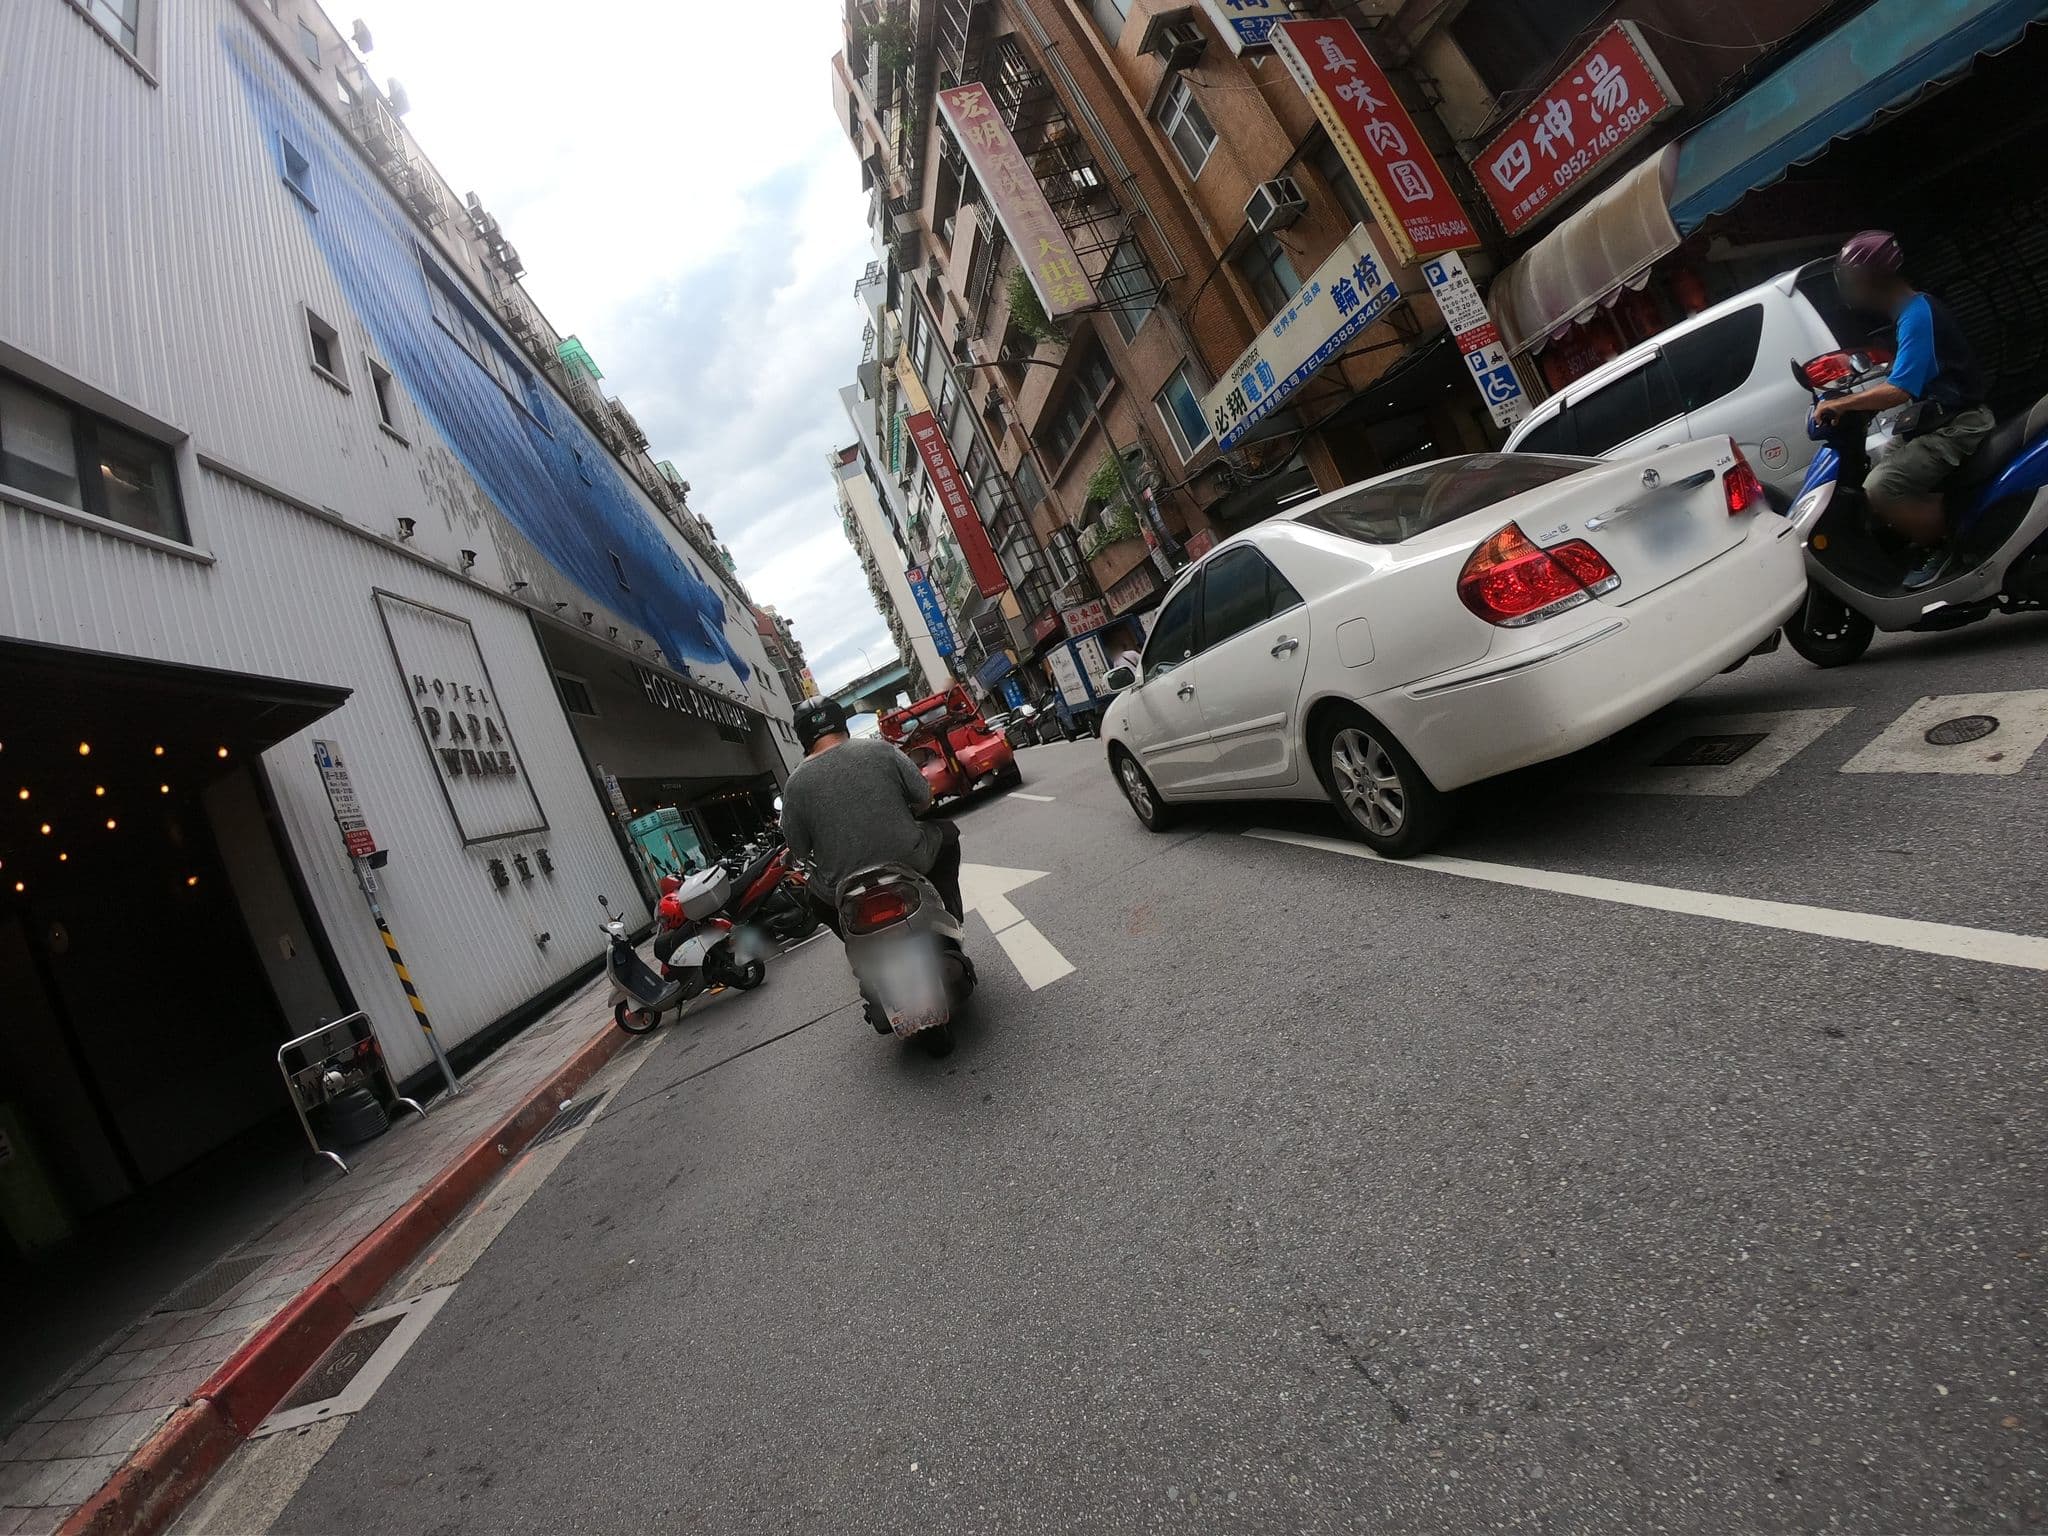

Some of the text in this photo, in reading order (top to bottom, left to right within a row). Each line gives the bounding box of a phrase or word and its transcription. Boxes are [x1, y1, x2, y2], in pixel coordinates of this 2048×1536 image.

[1315, 36, 1433, 202] 真味肉圓
[1491, 54, 1629, 193] 四神湯
[1553, 98, 1650, 186] 0952-746-984
[1330, 253, 1382, 318] 輪椅
[1231, 347, 1259, 384] SHOPRIDER
[1300, 291, 1391, 377] TEL:2388-8405
[413, 674, 489, 704] HOTEL
[639, 667, 692, 714] HOTEL
[422, 707, 503, 742] PAPA
